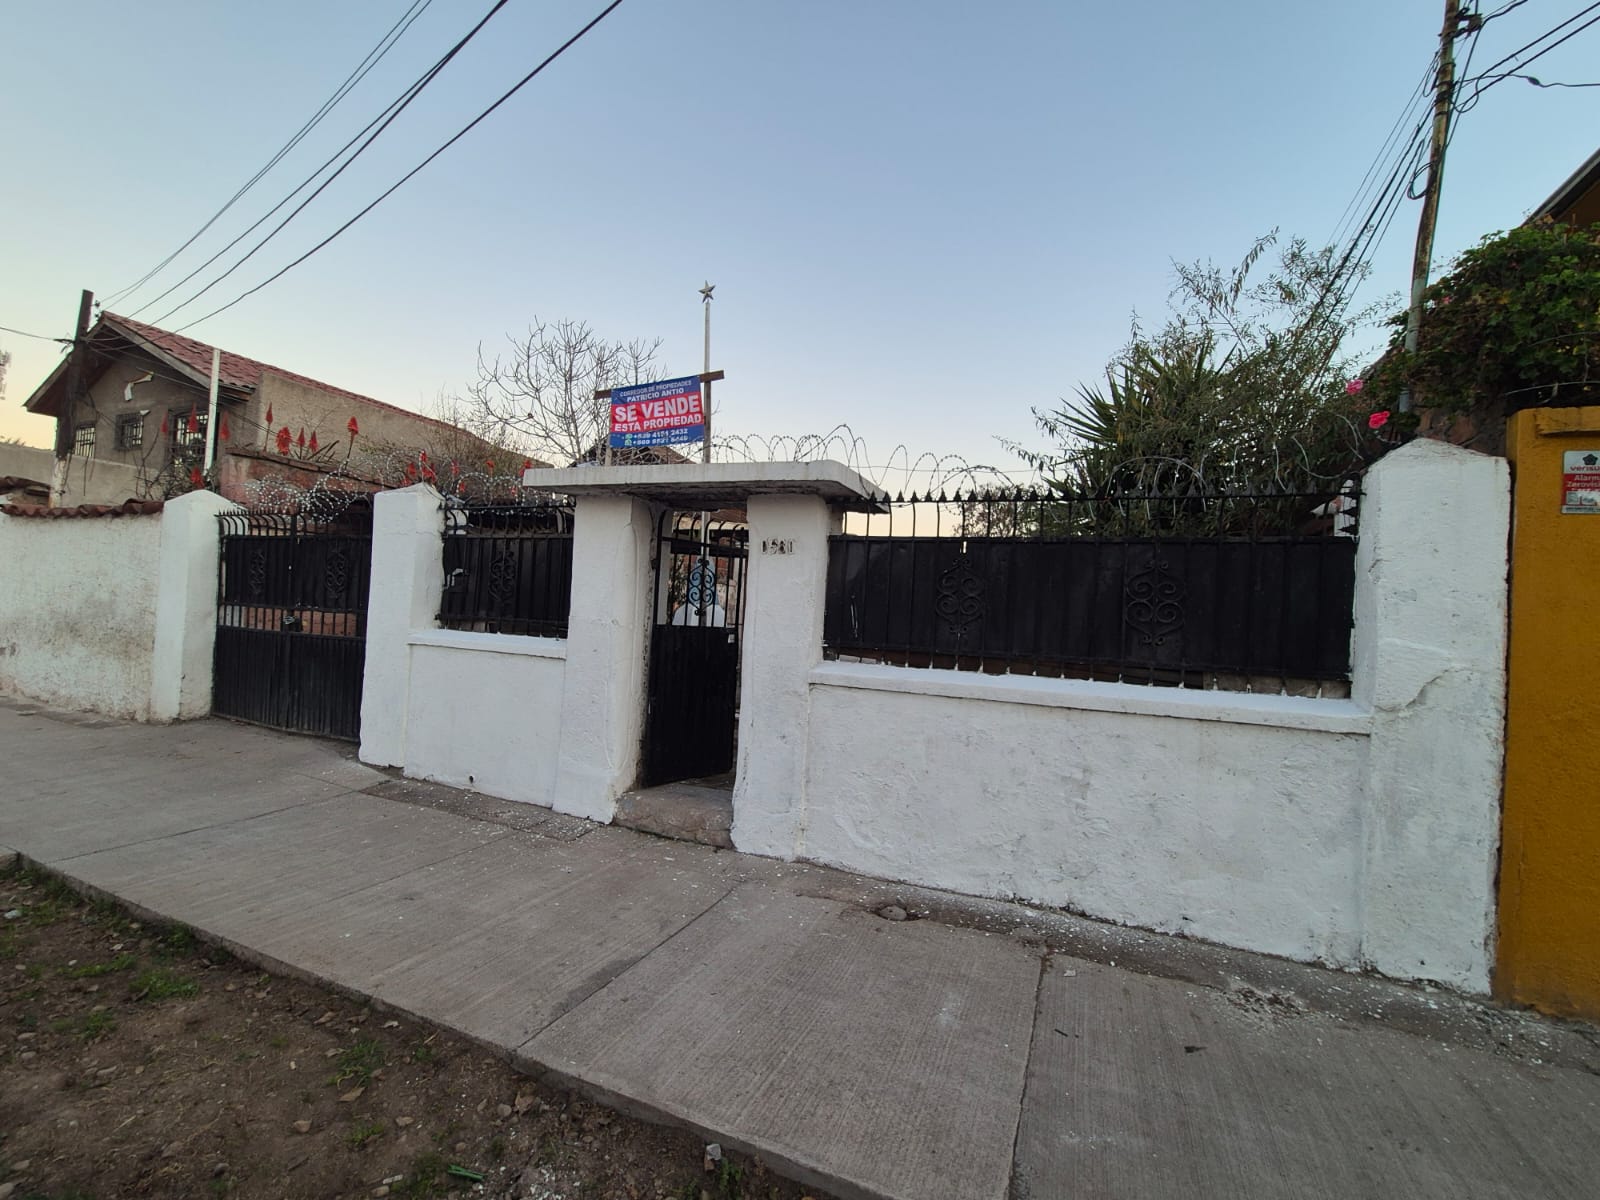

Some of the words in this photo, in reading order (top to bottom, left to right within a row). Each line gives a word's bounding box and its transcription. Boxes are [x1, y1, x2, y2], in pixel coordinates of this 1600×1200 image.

[620, 389, 648, 397] CORREDOR
[656, 380, 692, 391] PROPIEDADES
[627, 392, 660, 402] PATRICIO
[661, 388, 684, 397] ANTIO
[615, 404, 637, 423] SE
[640, 394, 700, 419] VENDE
[614, 422, 641, 432] ESTA
[643, 414, 702, 429] PROPIEDAD
